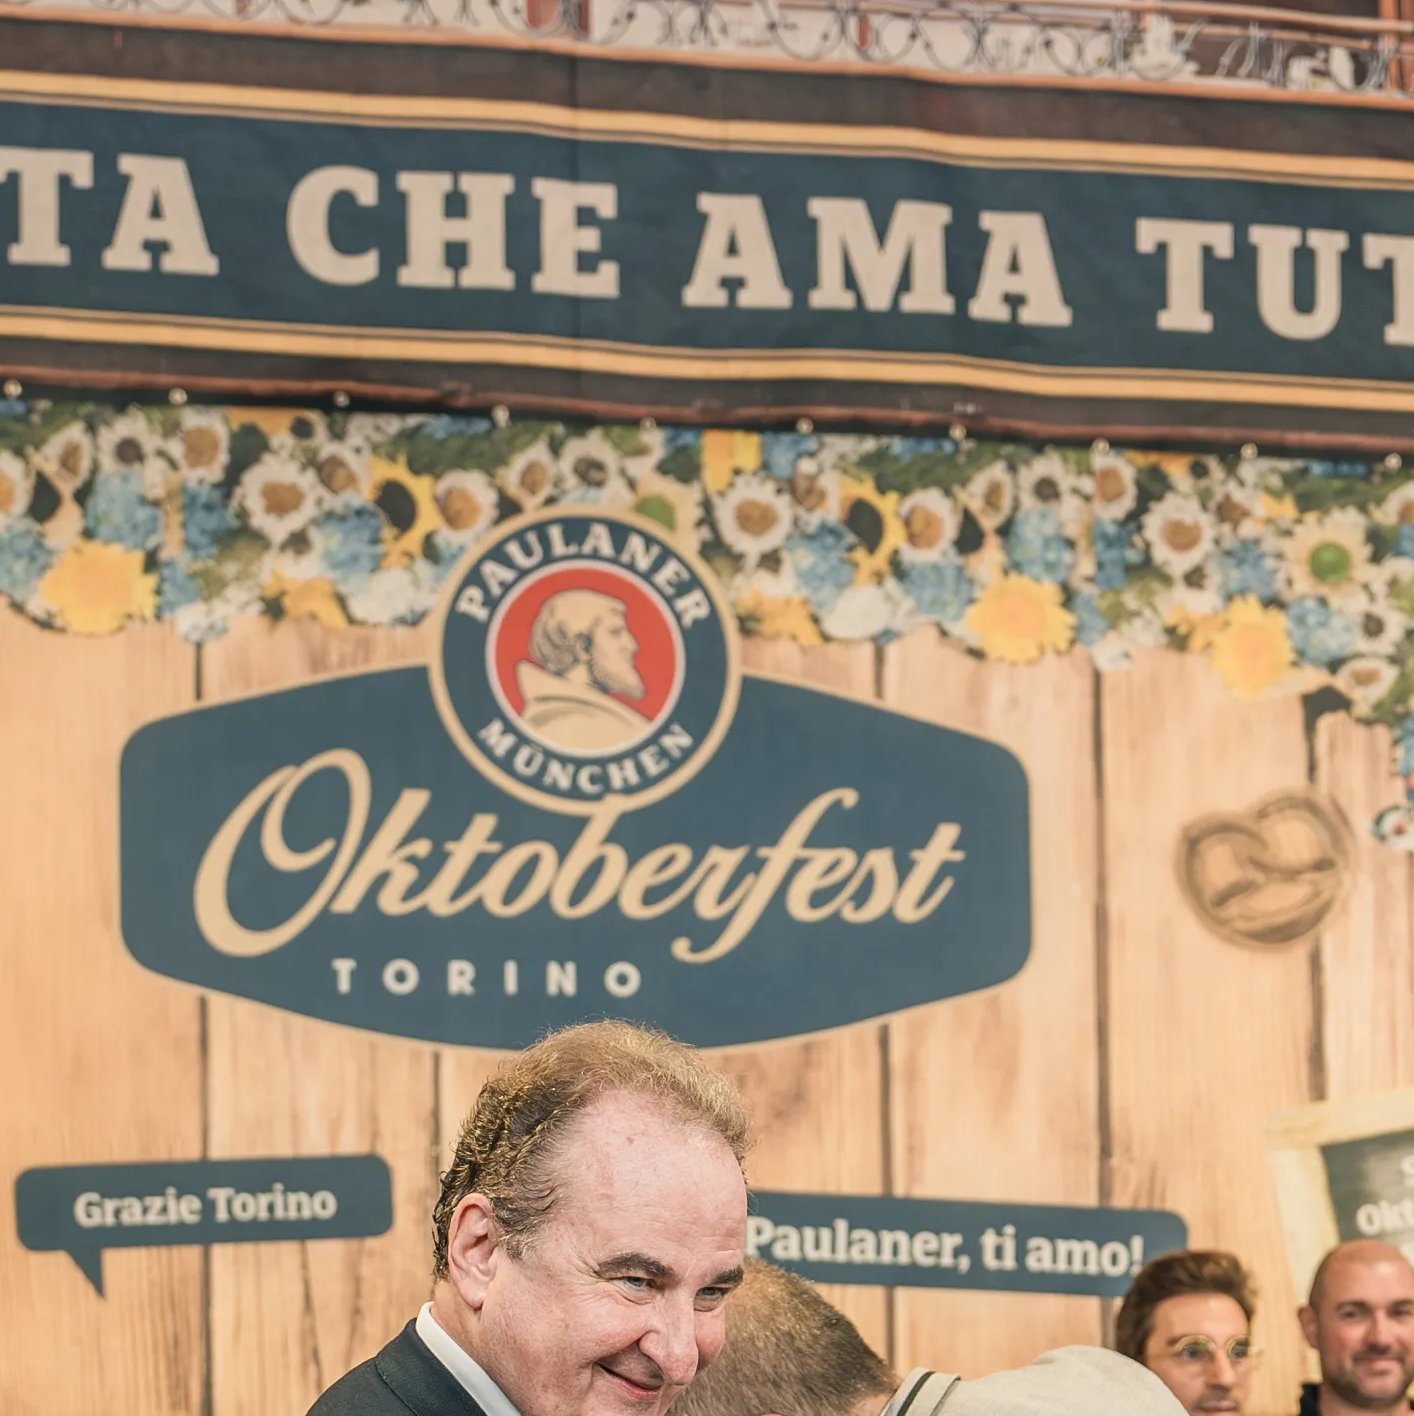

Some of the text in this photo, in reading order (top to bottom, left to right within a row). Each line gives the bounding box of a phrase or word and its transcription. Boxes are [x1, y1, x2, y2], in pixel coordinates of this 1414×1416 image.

[285, 164, 621, 299] CHE
[681, 192, 1073, 328] AMA
[454, 520, 712, 629] PAULANER
[477, 716, 694, 794] MÜNCHEN
[193, 748, 968, 964] Oktoberfest
[331, 957, 643, 998] TORINO
[73, 1181, 338, 1229] Grazie Torino
[747, 1215, 1145, 1277] Paulaner, ti amo!
